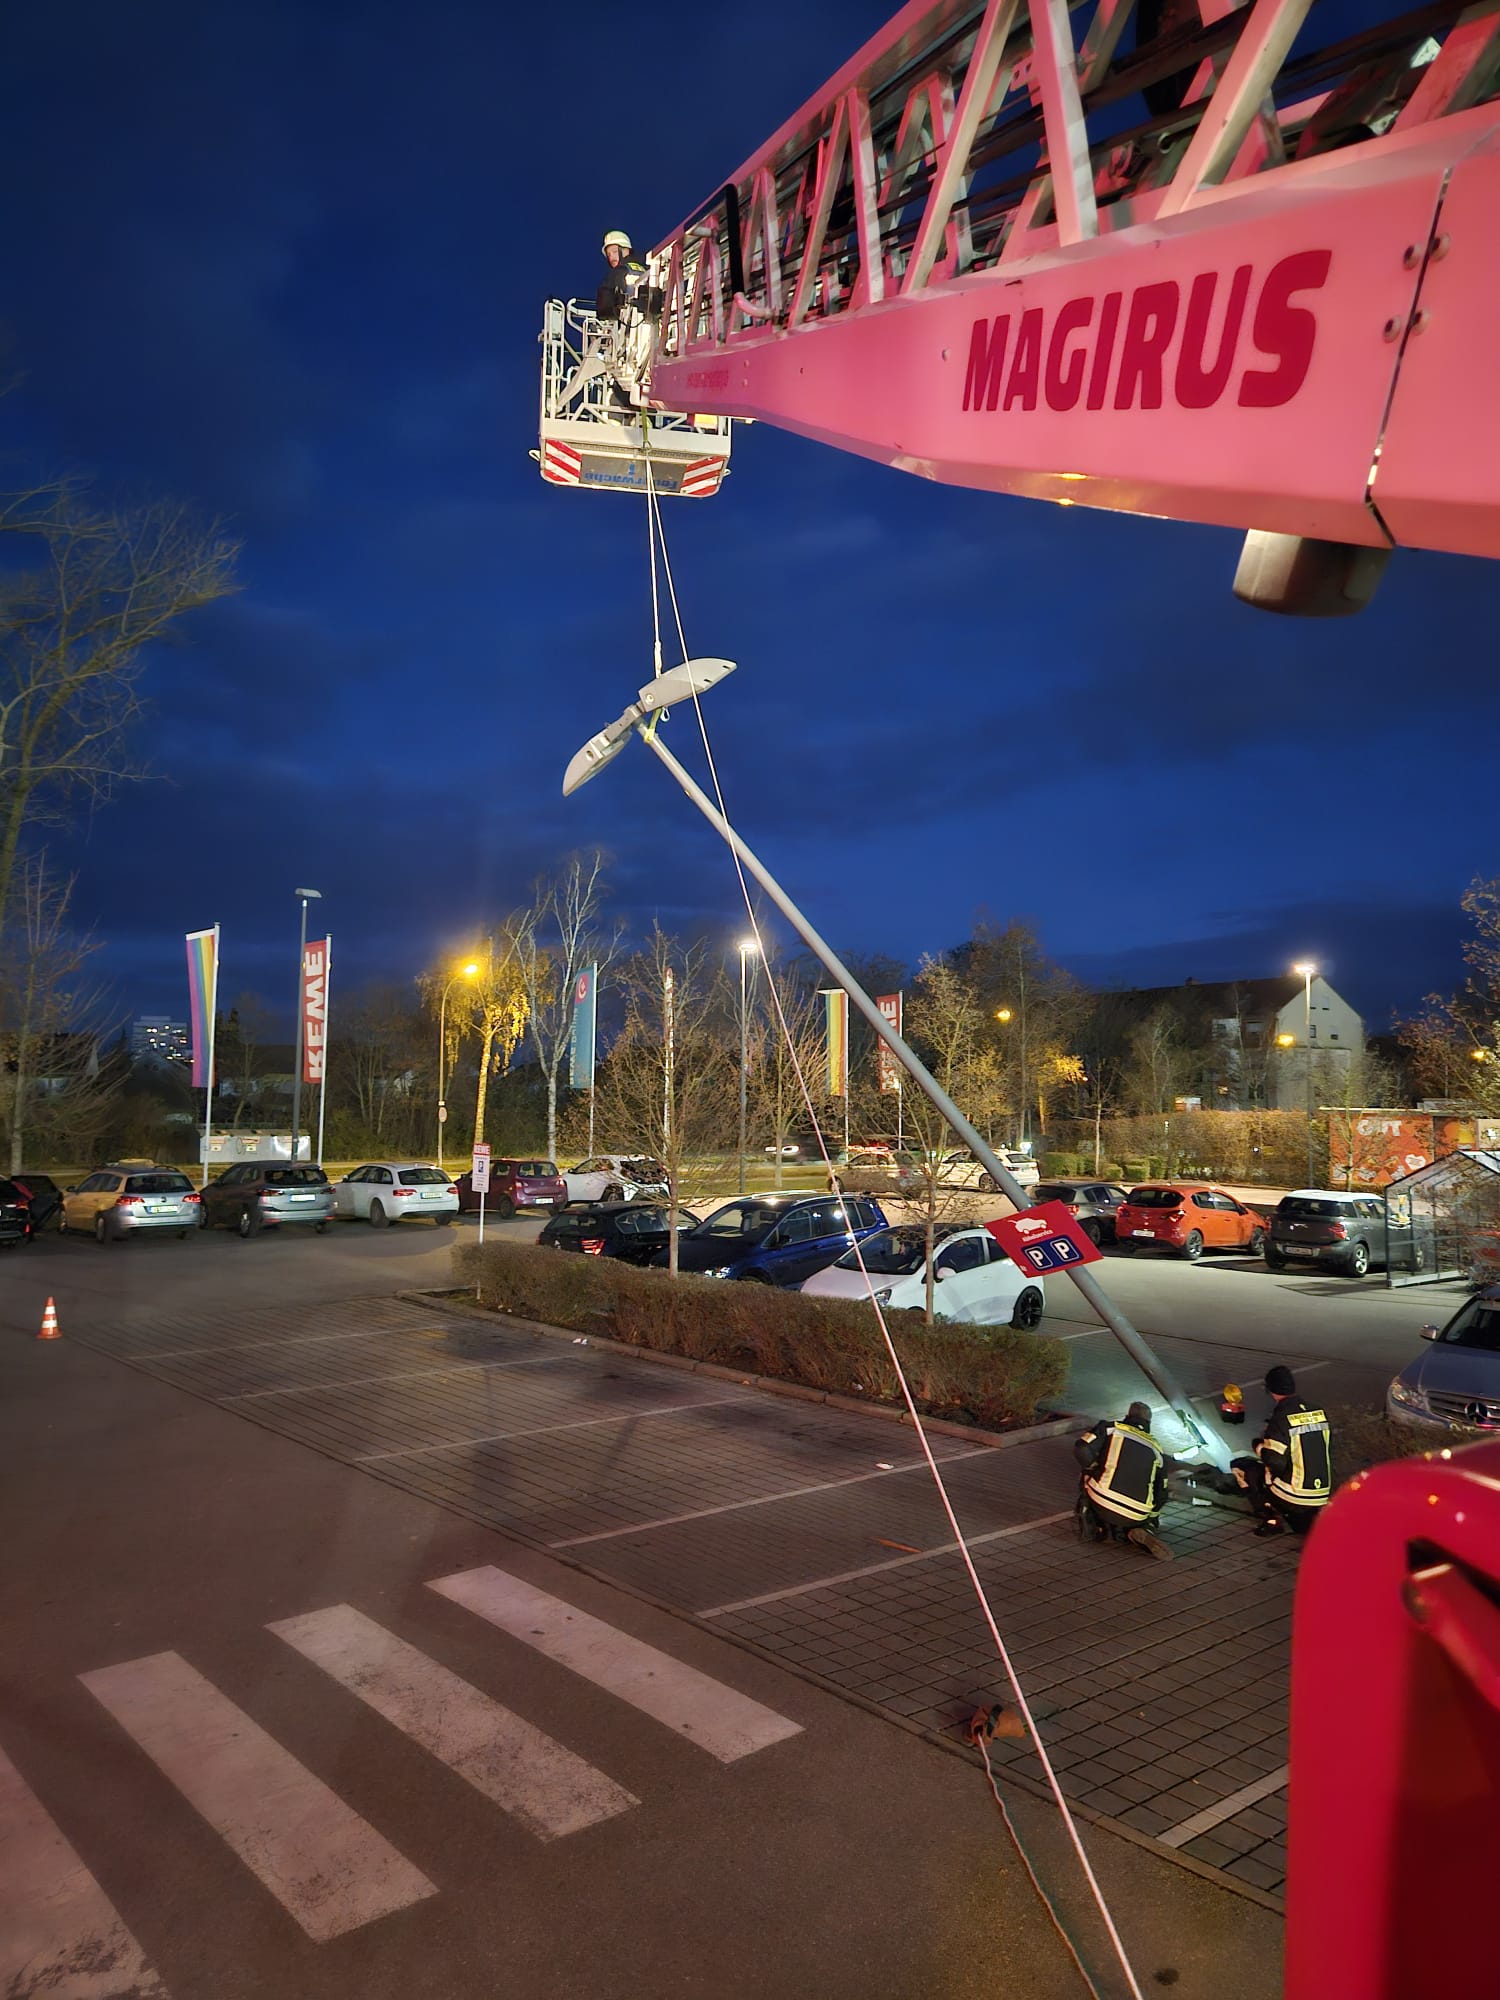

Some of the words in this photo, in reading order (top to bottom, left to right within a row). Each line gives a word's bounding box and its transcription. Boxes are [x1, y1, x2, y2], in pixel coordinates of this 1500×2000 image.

[962, 249, 1333, 412] MAGIRUS
[305, 951, 325, 1078] REWE
[1028, 1249, 1044, 1267] P
[1054, 1241, 1070, 1259] P
